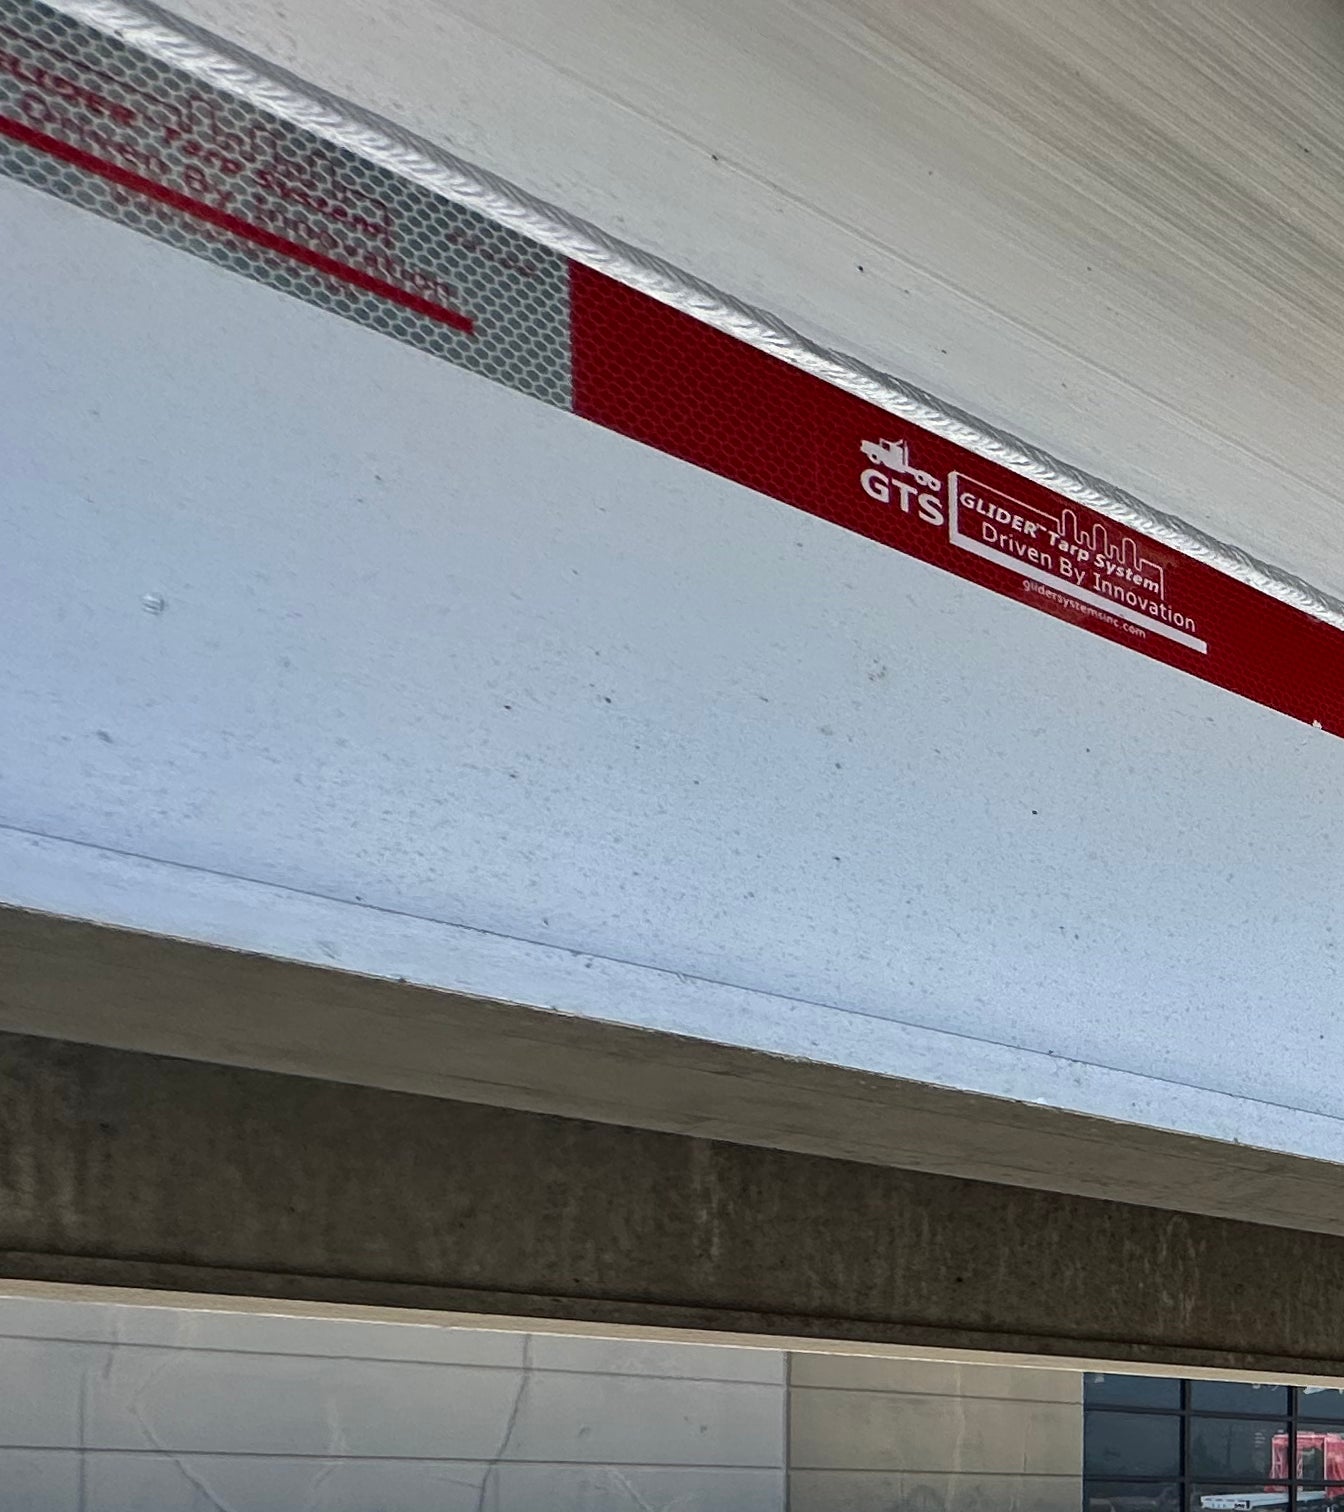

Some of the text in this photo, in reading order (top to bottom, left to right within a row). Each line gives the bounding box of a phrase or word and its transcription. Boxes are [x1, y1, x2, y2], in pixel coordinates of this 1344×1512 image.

[20, 91, 172, 176] Driven
[183, 164, 237, 212] By
[860, 468, 945, 526] GTS
[982, 521, 1196, 633] Driven By Innovation
[1048, 531, 1090, 562] Tarp
[1094, 554, 1159, 594] System
